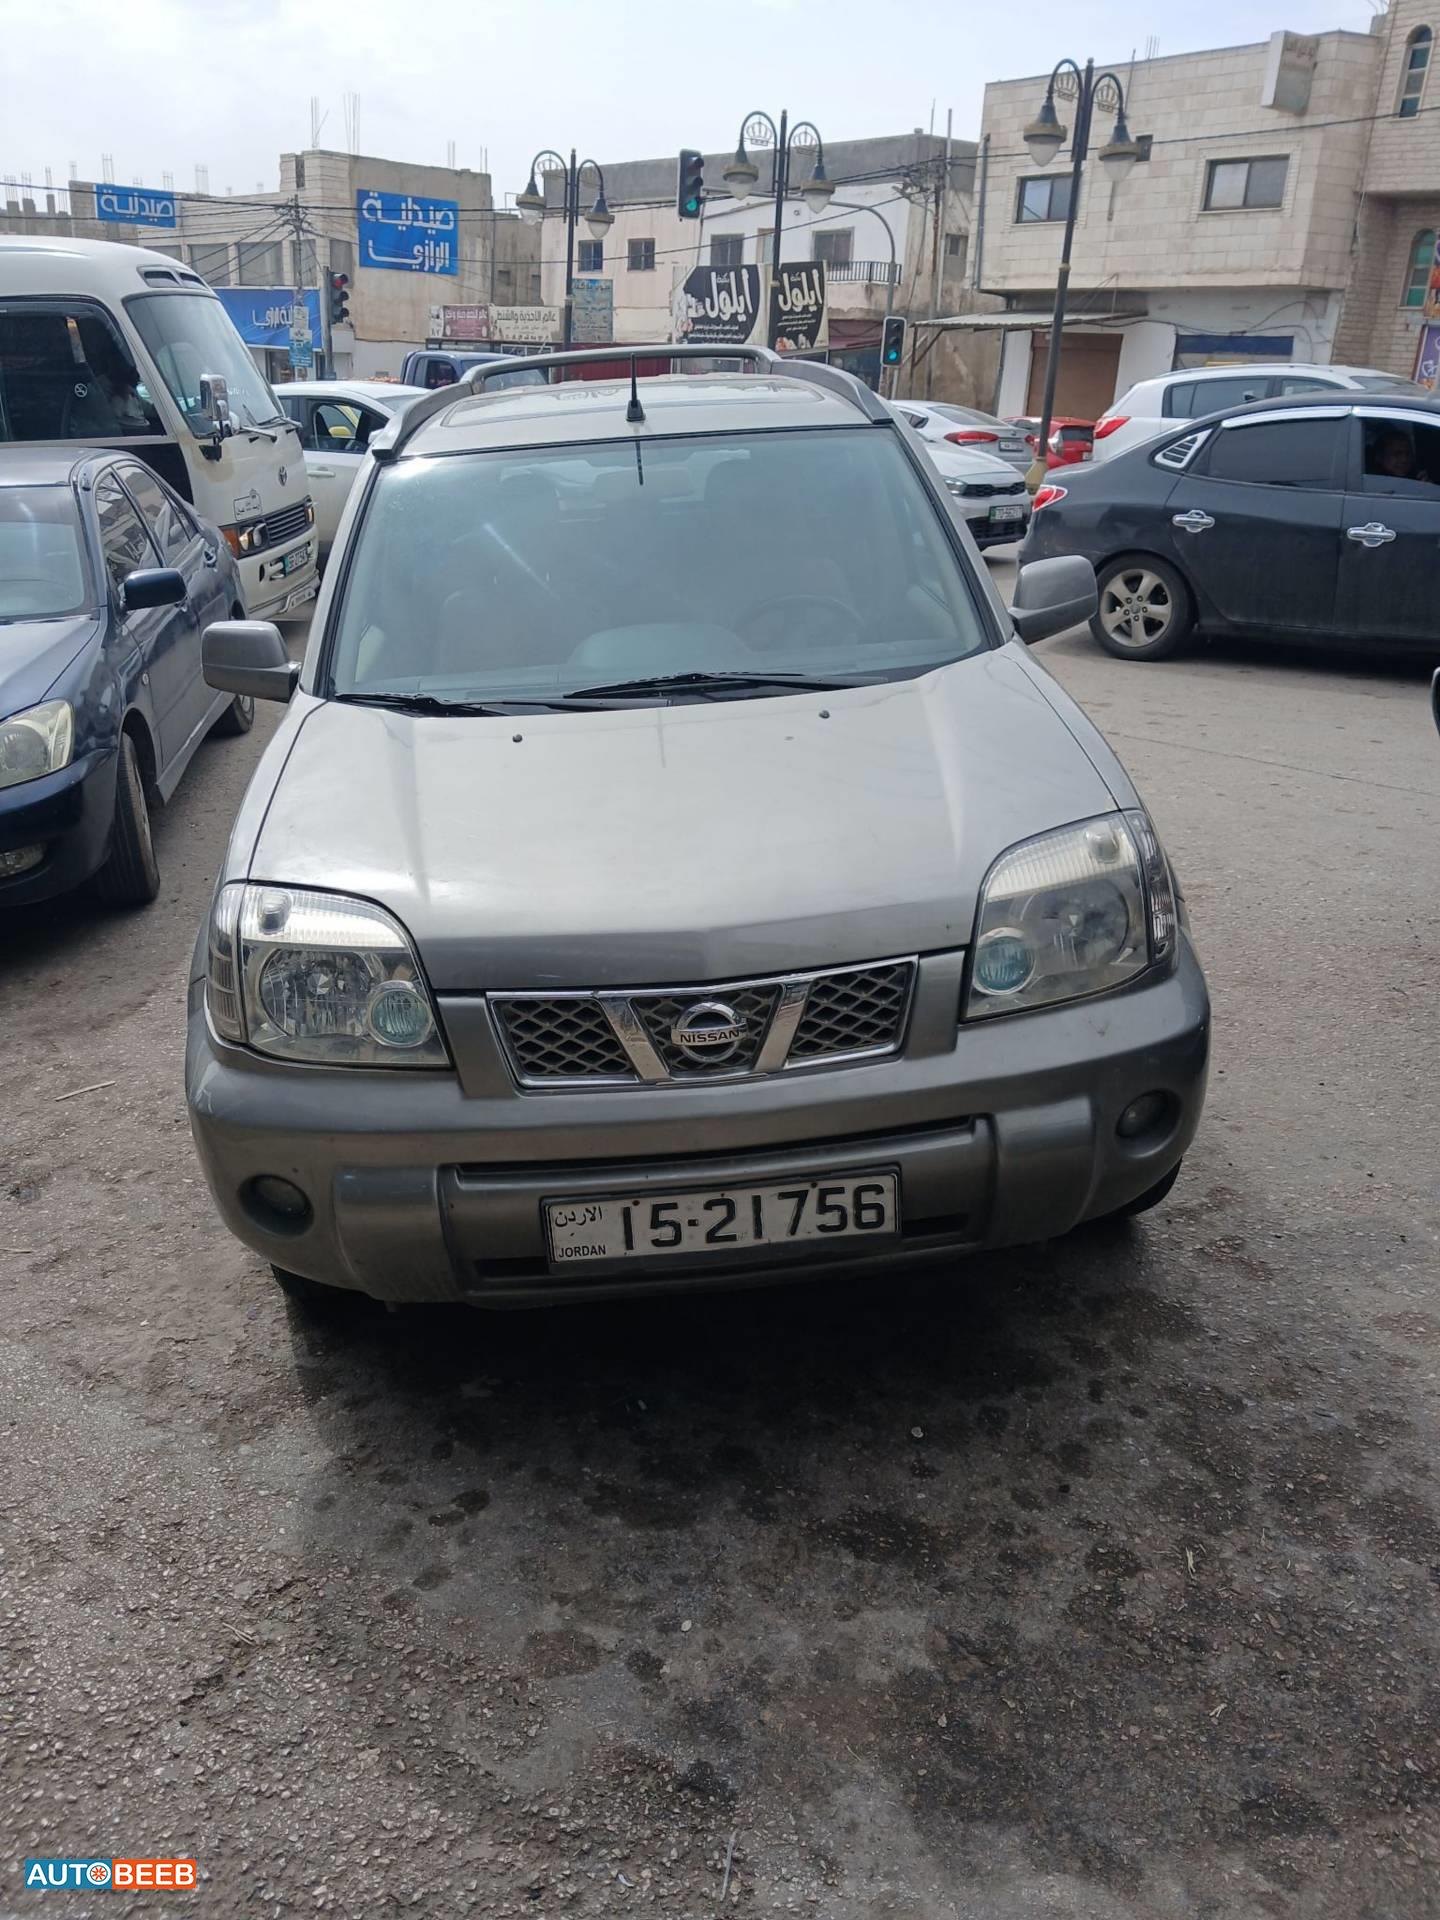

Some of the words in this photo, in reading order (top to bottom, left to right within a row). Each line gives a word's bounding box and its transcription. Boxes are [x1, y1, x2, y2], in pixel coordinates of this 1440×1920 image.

[100, 189, 173, 222] صيدلية
[362, 192, 454, 235] صيدلية
[368, 239, 449, 272] الرازي
[680, 1030, 739, 1043] NISSAN
[623, 1183, 886, 1251] 15-21756
[558, 1244, 607, 1258] JORDAN
